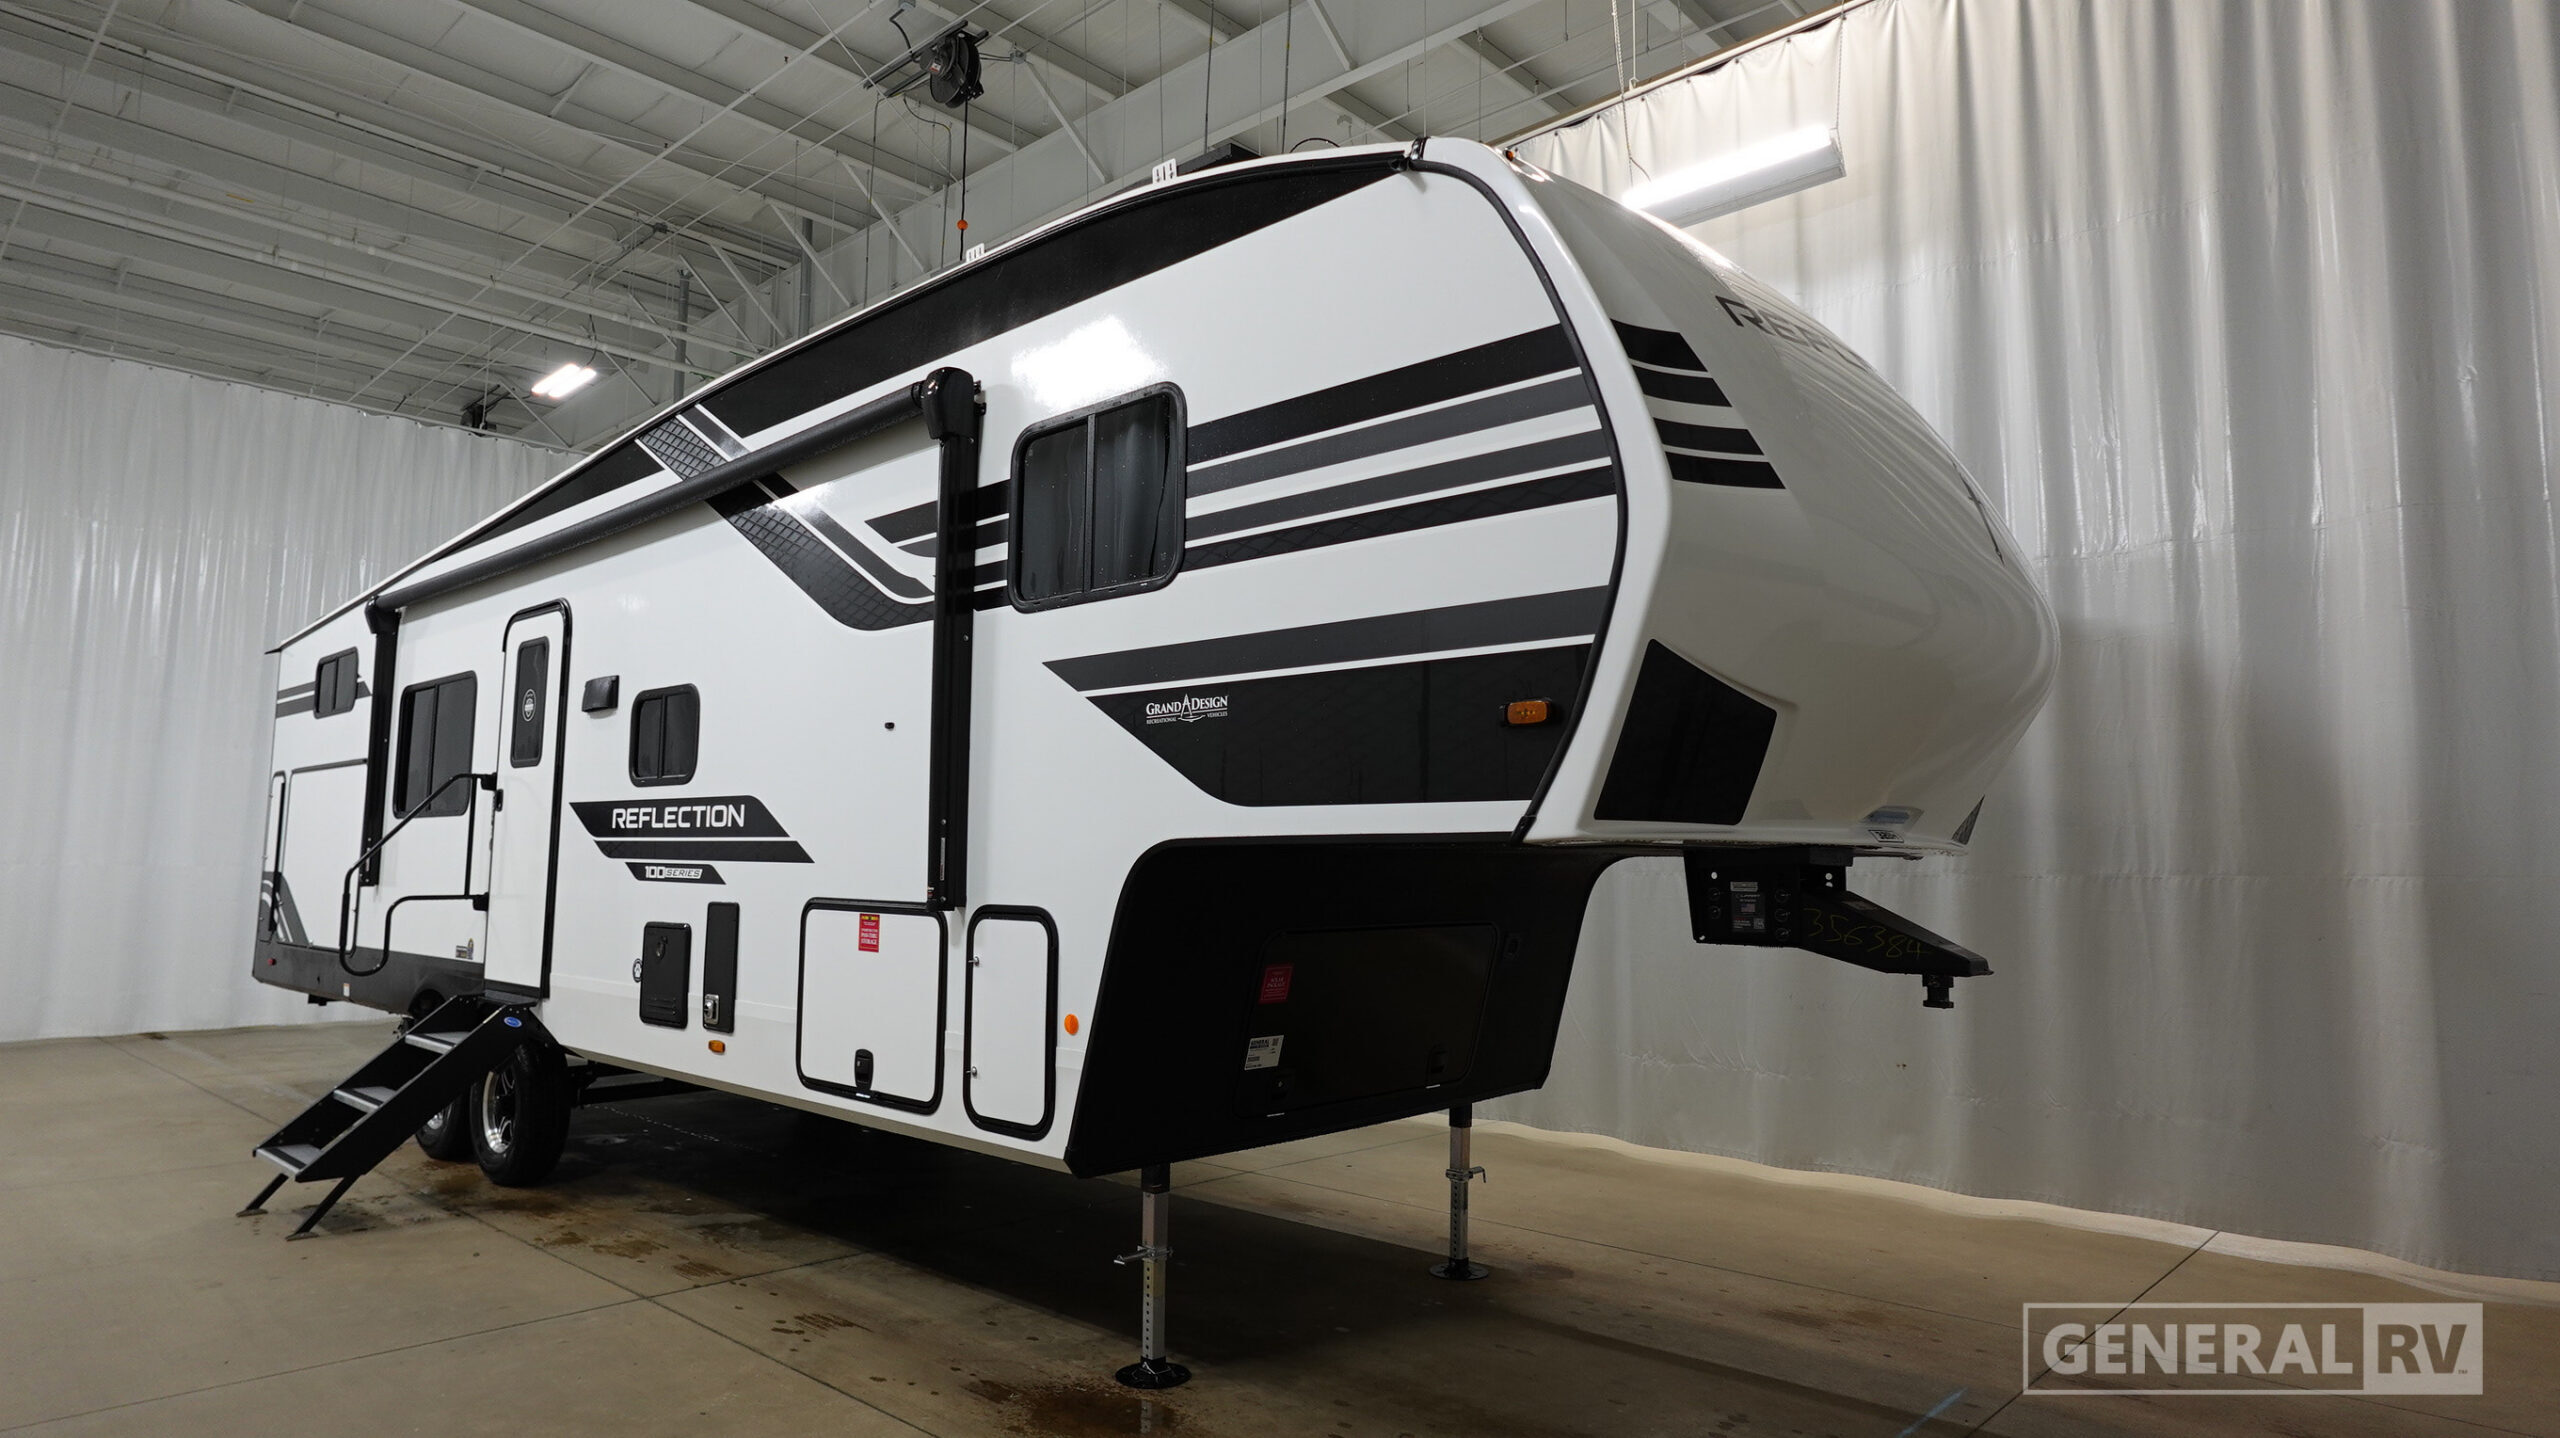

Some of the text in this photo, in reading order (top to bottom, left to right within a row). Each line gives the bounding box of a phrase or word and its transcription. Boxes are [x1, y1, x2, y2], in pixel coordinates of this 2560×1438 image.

[1146, 696, 1228, 715] GRAND DESIGN
[612, 804, 745, 829] REFLECTION
[645, 866, 701, 878] 100 SERIES
[1802, 907, 1932, 960] 356384
